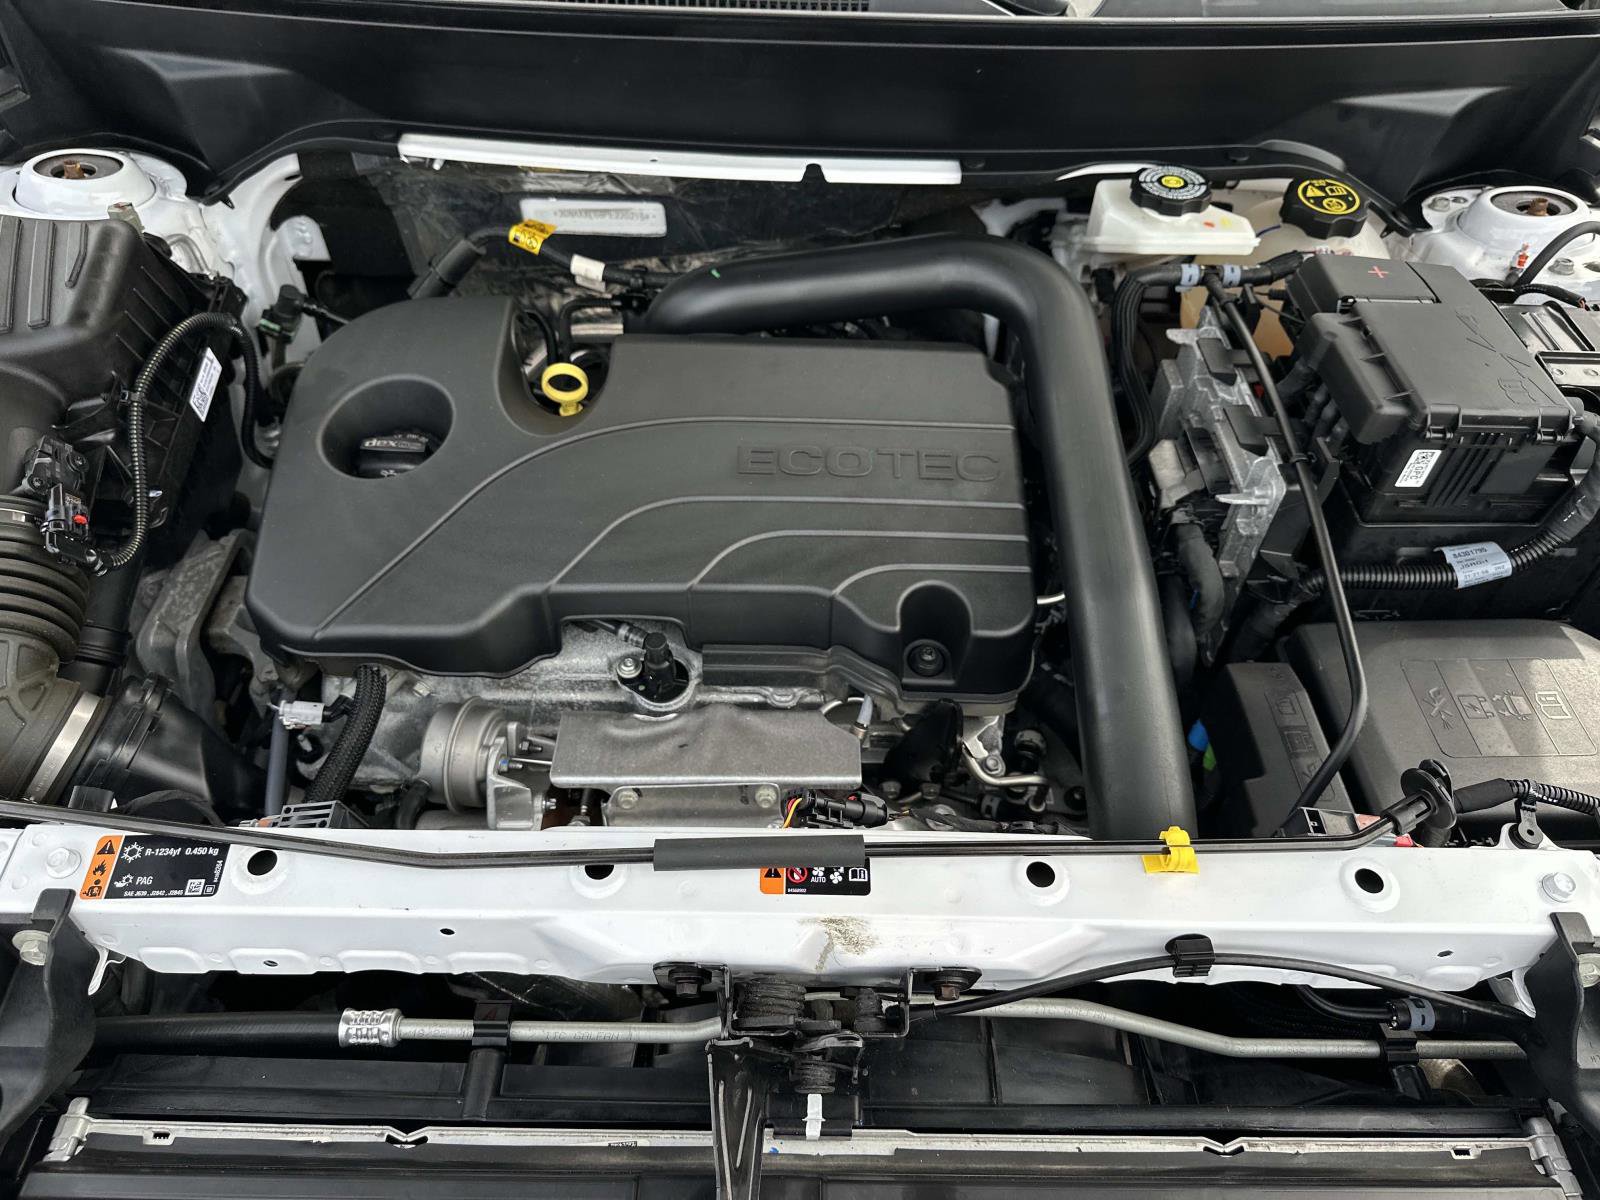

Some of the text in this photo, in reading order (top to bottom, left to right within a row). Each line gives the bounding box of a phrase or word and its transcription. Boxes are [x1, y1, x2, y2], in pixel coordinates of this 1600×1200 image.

[737, 445, 999, 482] ECOTEC
[145, 847, 219, 857] R-1234yf 0.450 kg
[135, 876, 154, 885] PAG
